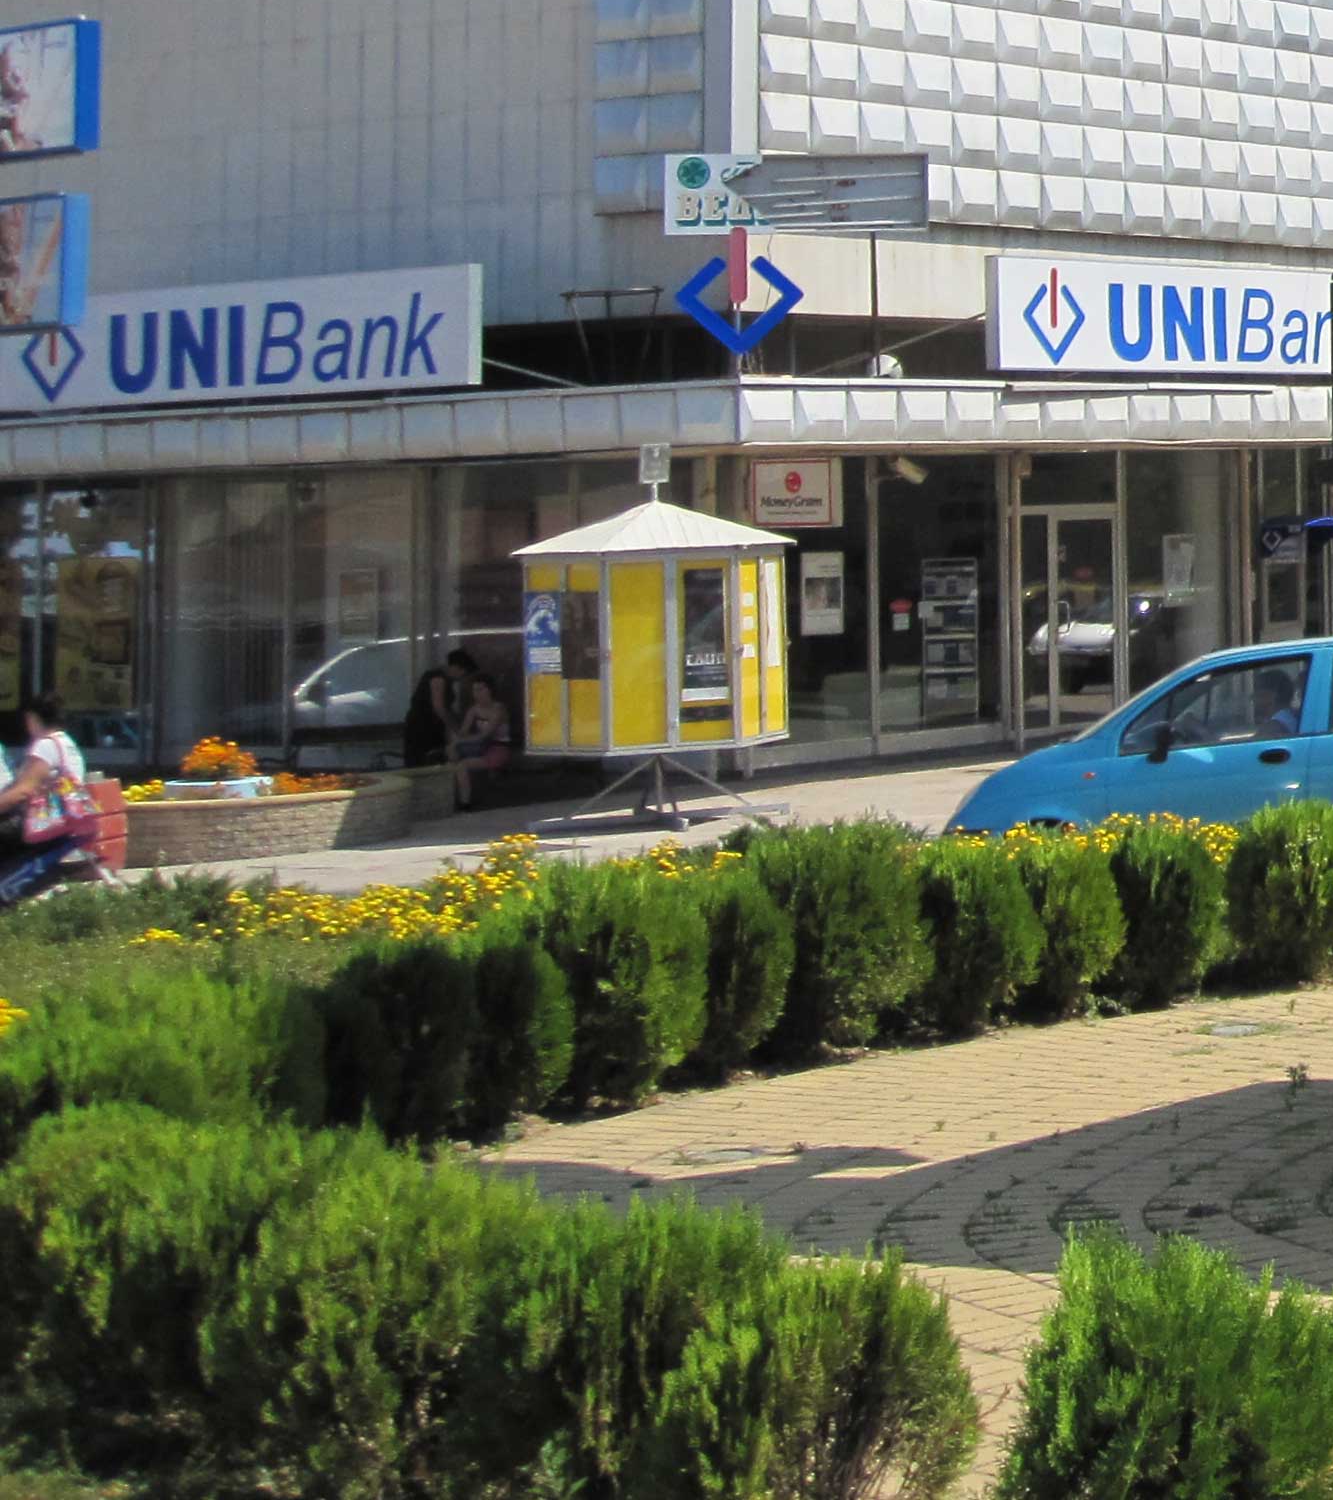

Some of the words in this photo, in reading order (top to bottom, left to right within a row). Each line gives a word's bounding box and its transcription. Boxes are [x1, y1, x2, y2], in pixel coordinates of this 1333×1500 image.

[675, 192, 769, 227] ВЕД
[109, 291, 445, 394] UNIBank
[760, 495, 823, 509] MoneyGram
